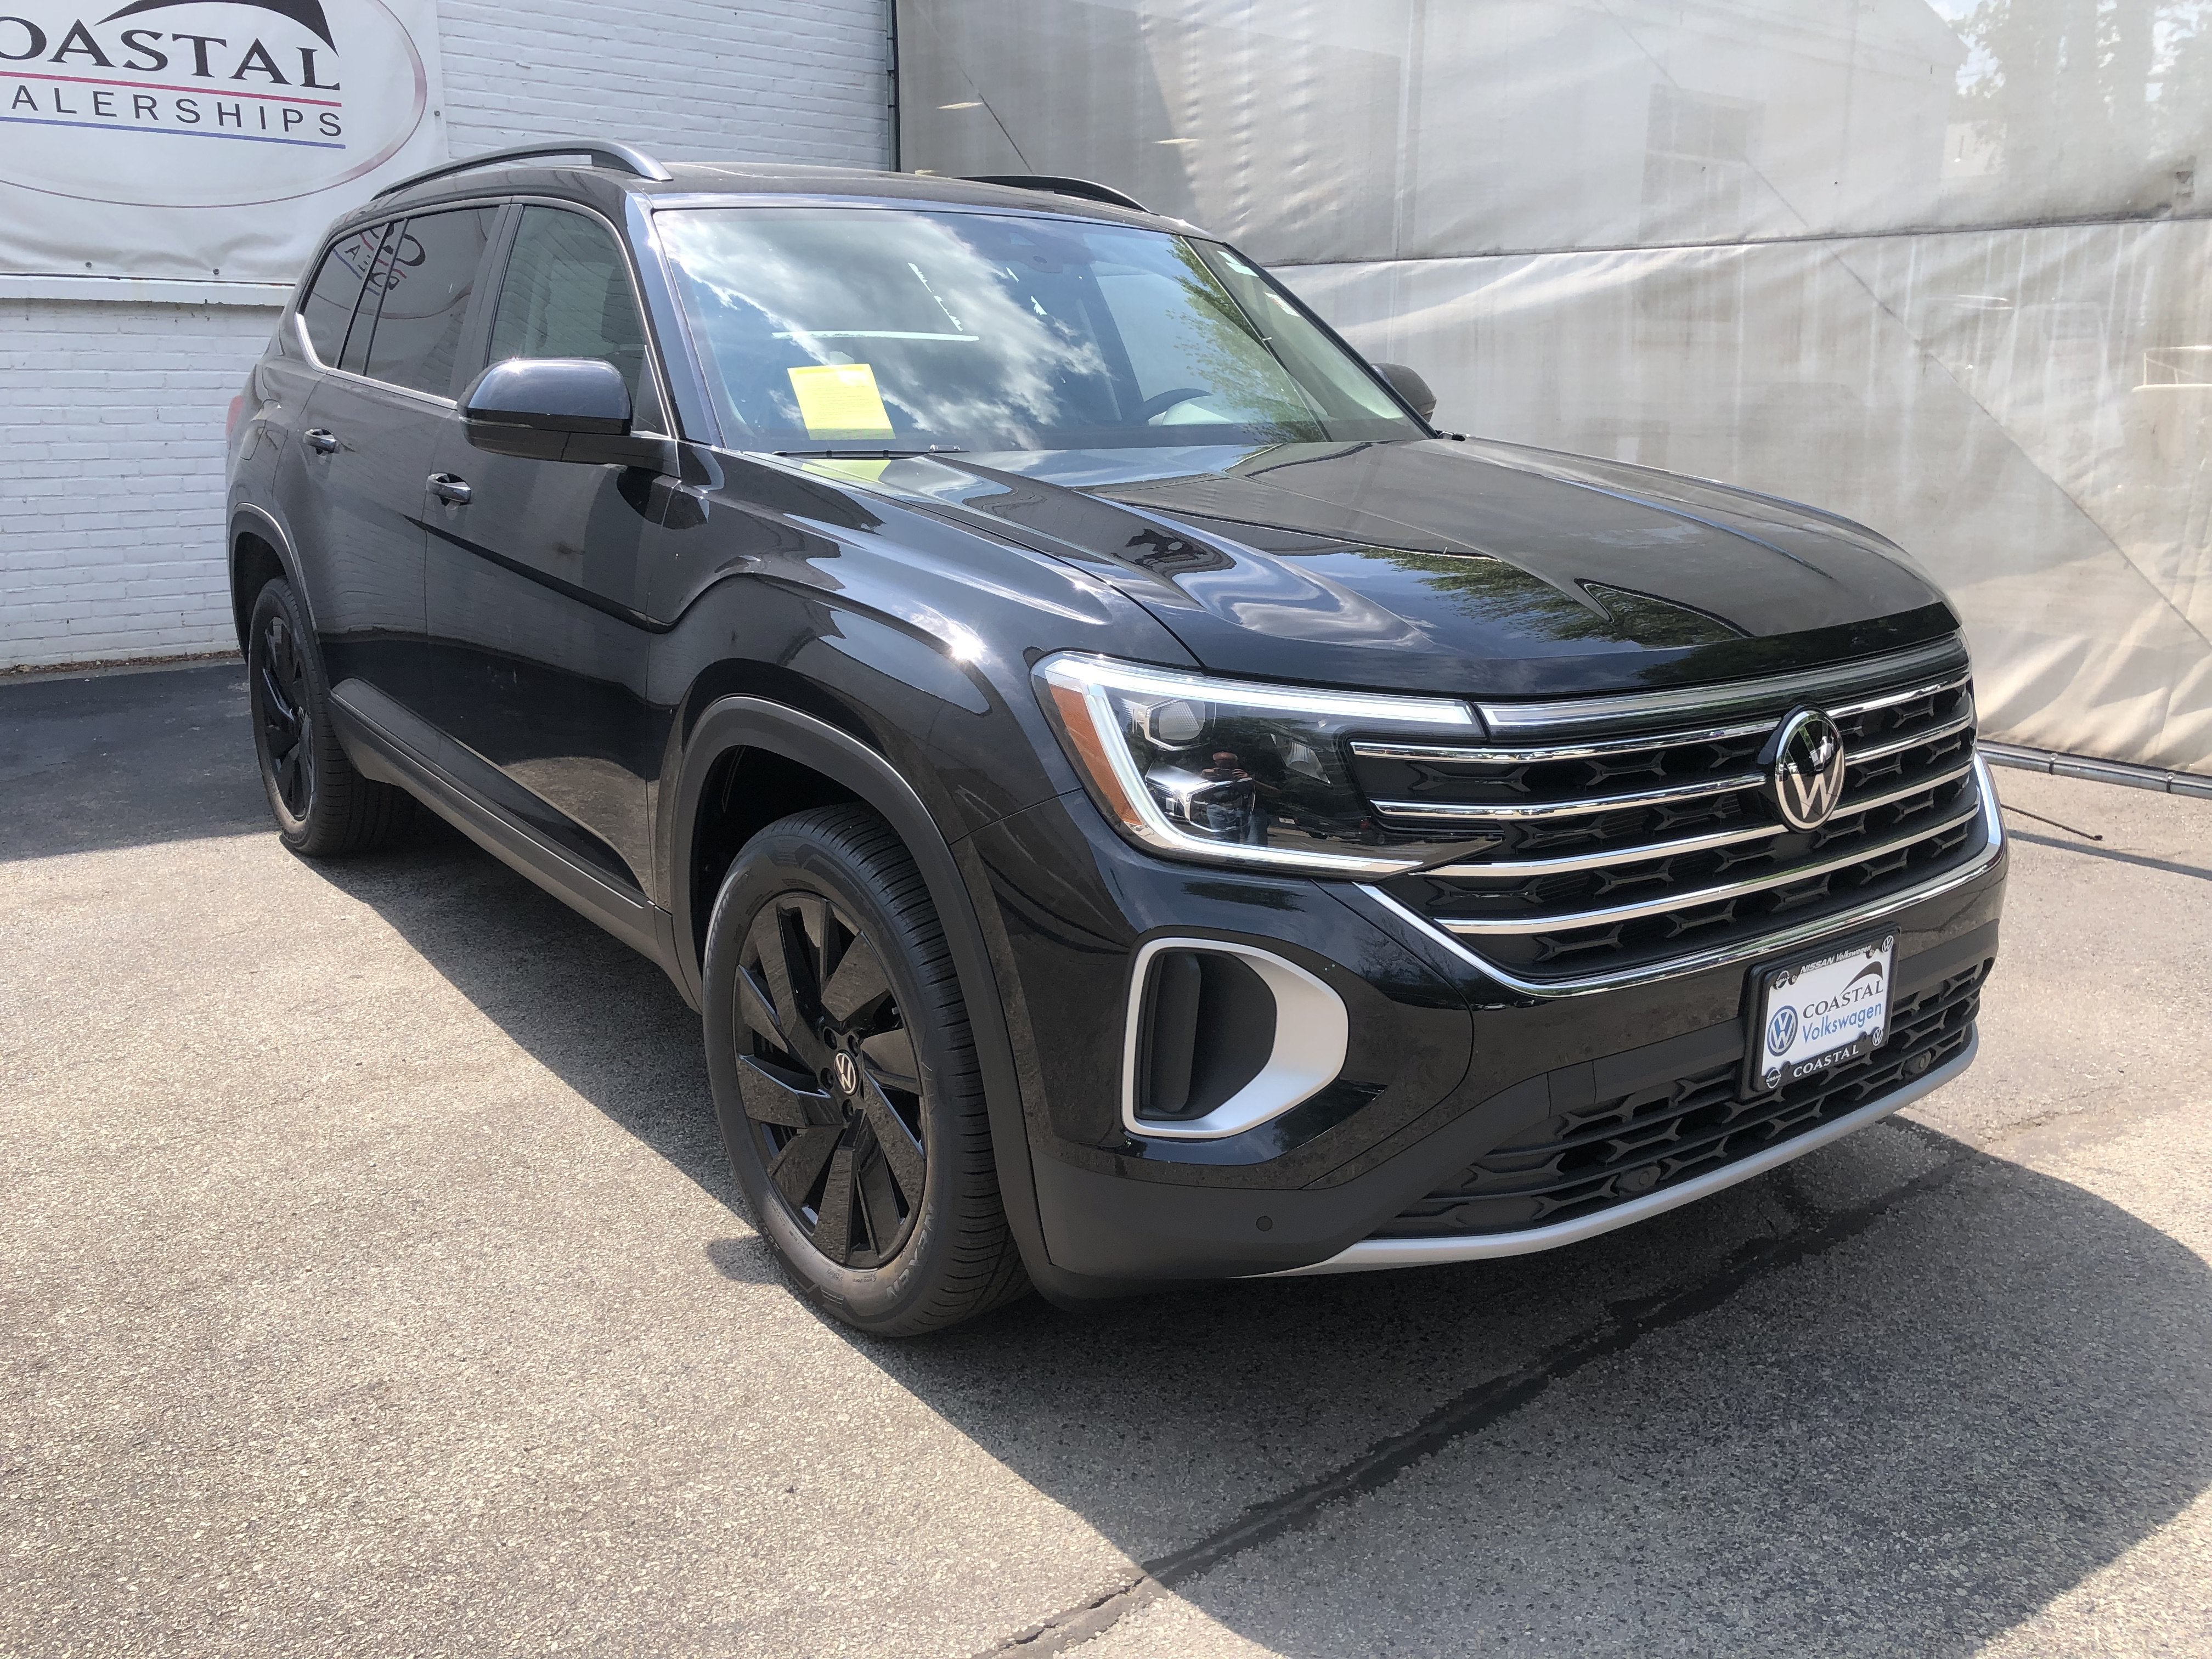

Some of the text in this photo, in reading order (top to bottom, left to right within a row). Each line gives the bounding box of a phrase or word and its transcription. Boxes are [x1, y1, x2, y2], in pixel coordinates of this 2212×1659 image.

[11, 84, 342, 137] ALERSHIPS
[1800, 945, 1872, 974] NISSAN Volkswagen
[1803, 980, 1884, 1019] COASTAL
[1802, 1003, 1882, 1044] Volkswagen
[1793, 1044, 1859, 1078] COASTAL
